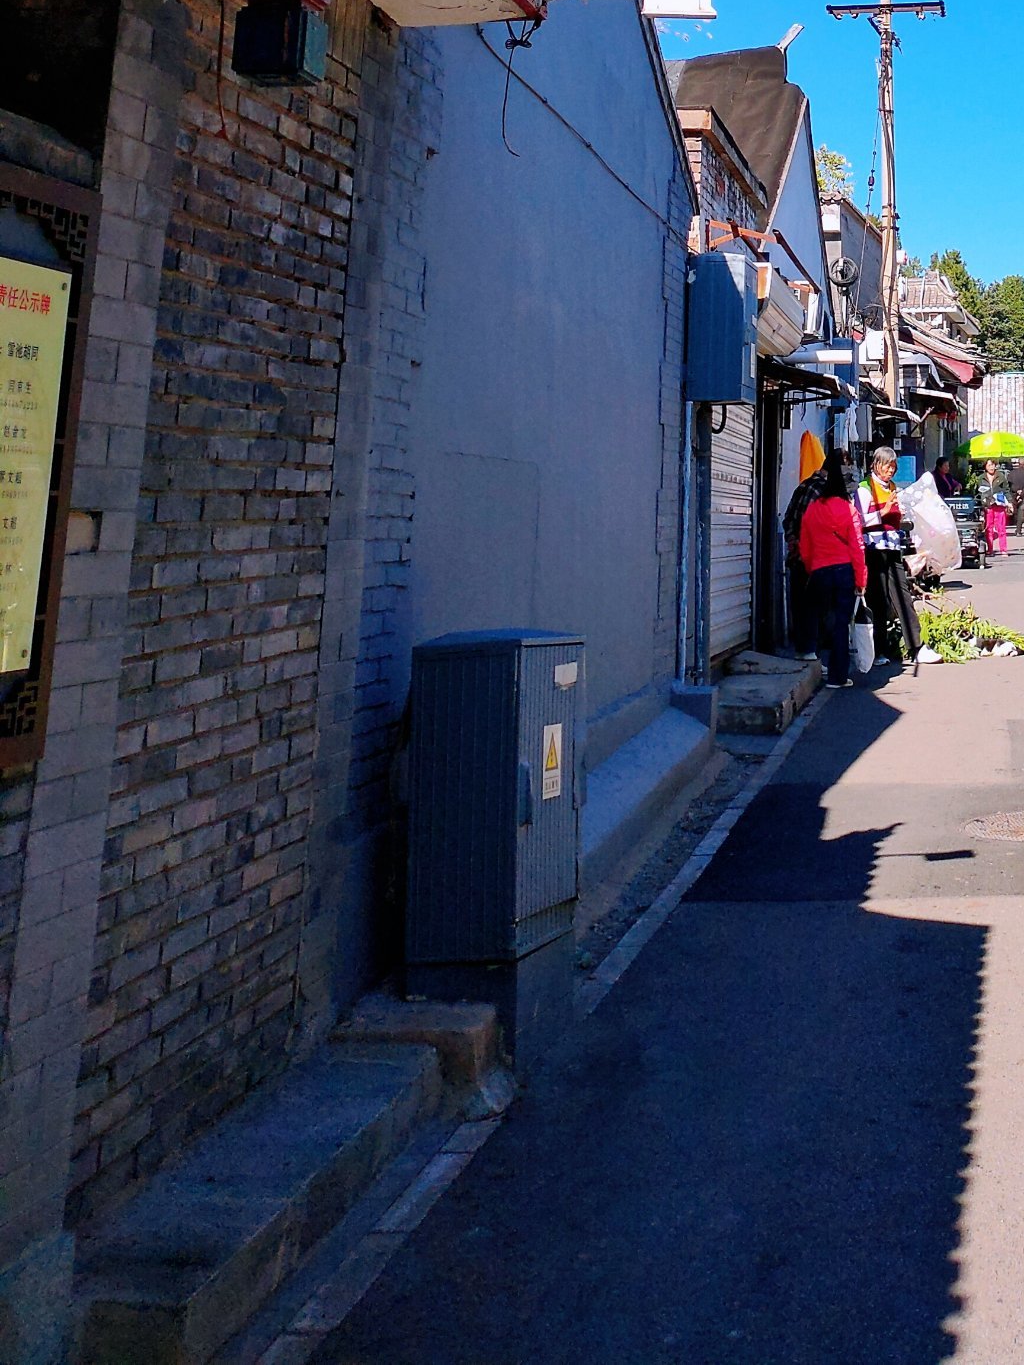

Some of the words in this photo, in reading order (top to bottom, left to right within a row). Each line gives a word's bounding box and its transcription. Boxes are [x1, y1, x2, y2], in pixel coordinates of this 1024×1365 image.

[0, 284, 51, 315] 责任公示牌
